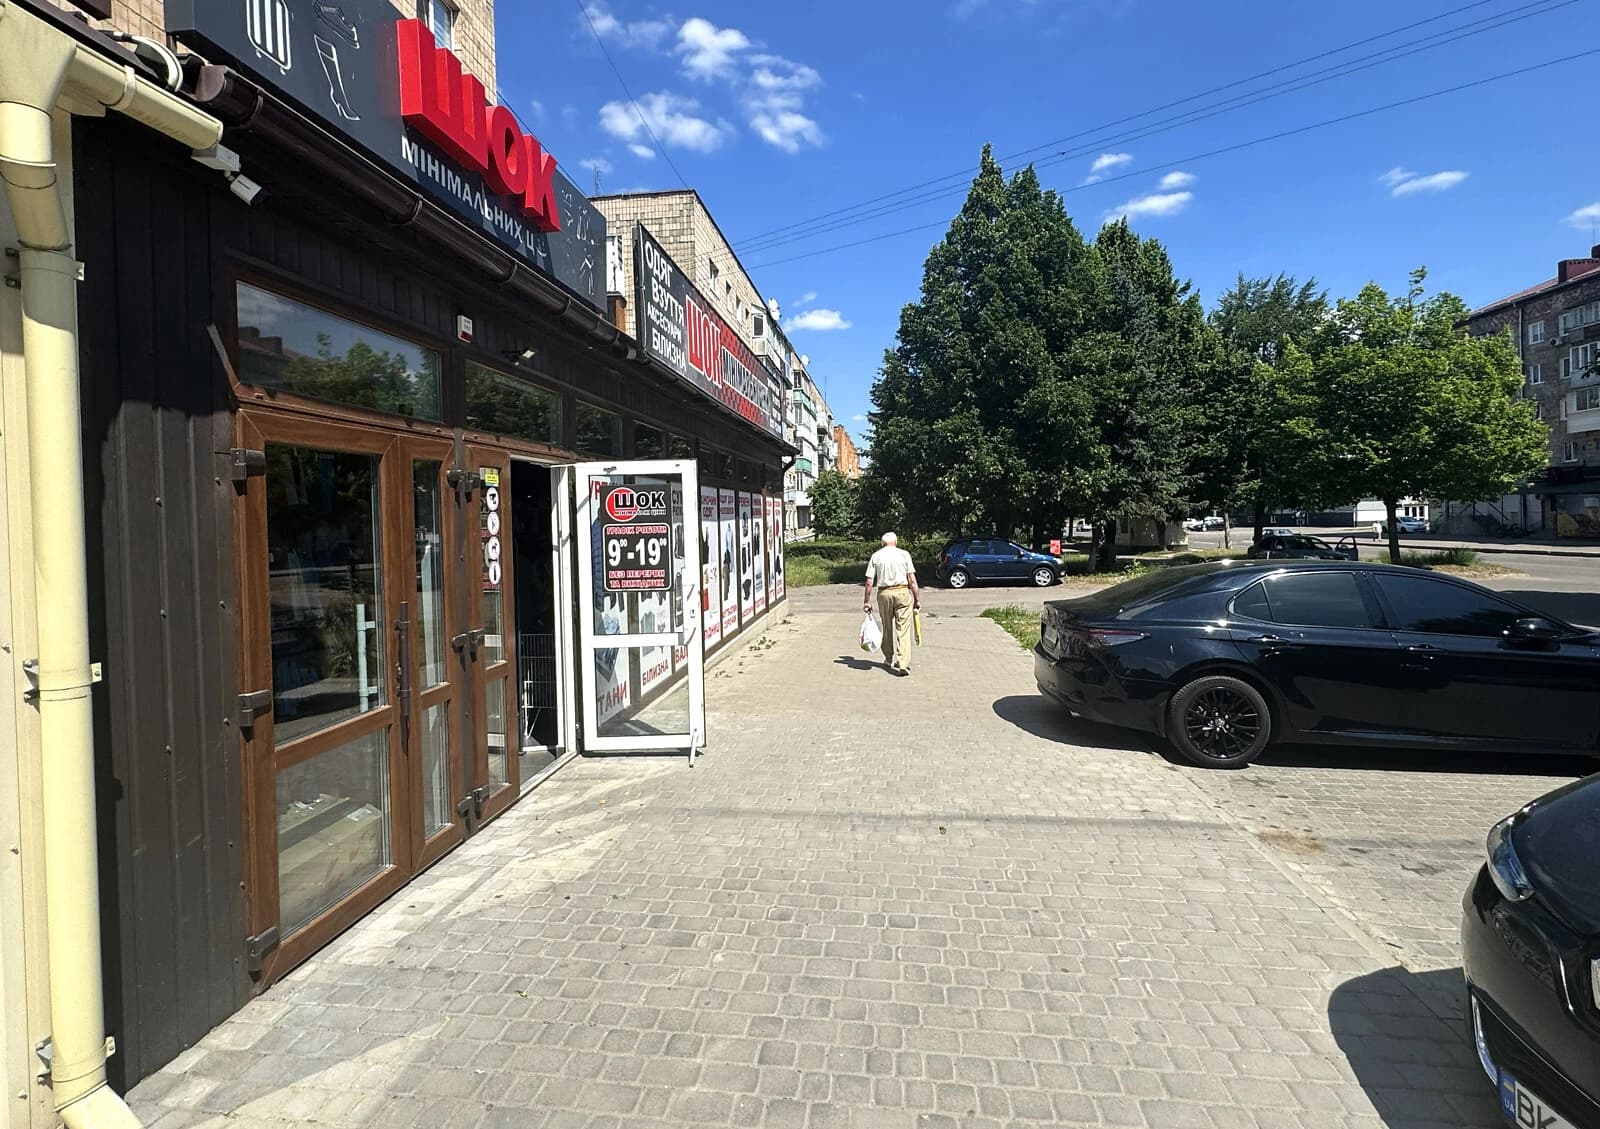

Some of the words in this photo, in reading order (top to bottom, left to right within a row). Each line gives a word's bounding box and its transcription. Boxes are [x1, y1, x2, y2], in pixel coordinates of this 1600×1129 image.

[397, 18, 561, 232] ШОК
[645, 241, 672, 288] ОДЯГ
[647, 302, 682, 345] АКСЕСУАРИ
[651, 277, 685, 328] ВЗУТТЯ
[652, 327, 688, 372] БІЛИЗНА
[686, 294, 722, 389] ШОК
[613, 491, 667, 509] ШОК
[642, 658, 669, 686] БІЛИЗНА
